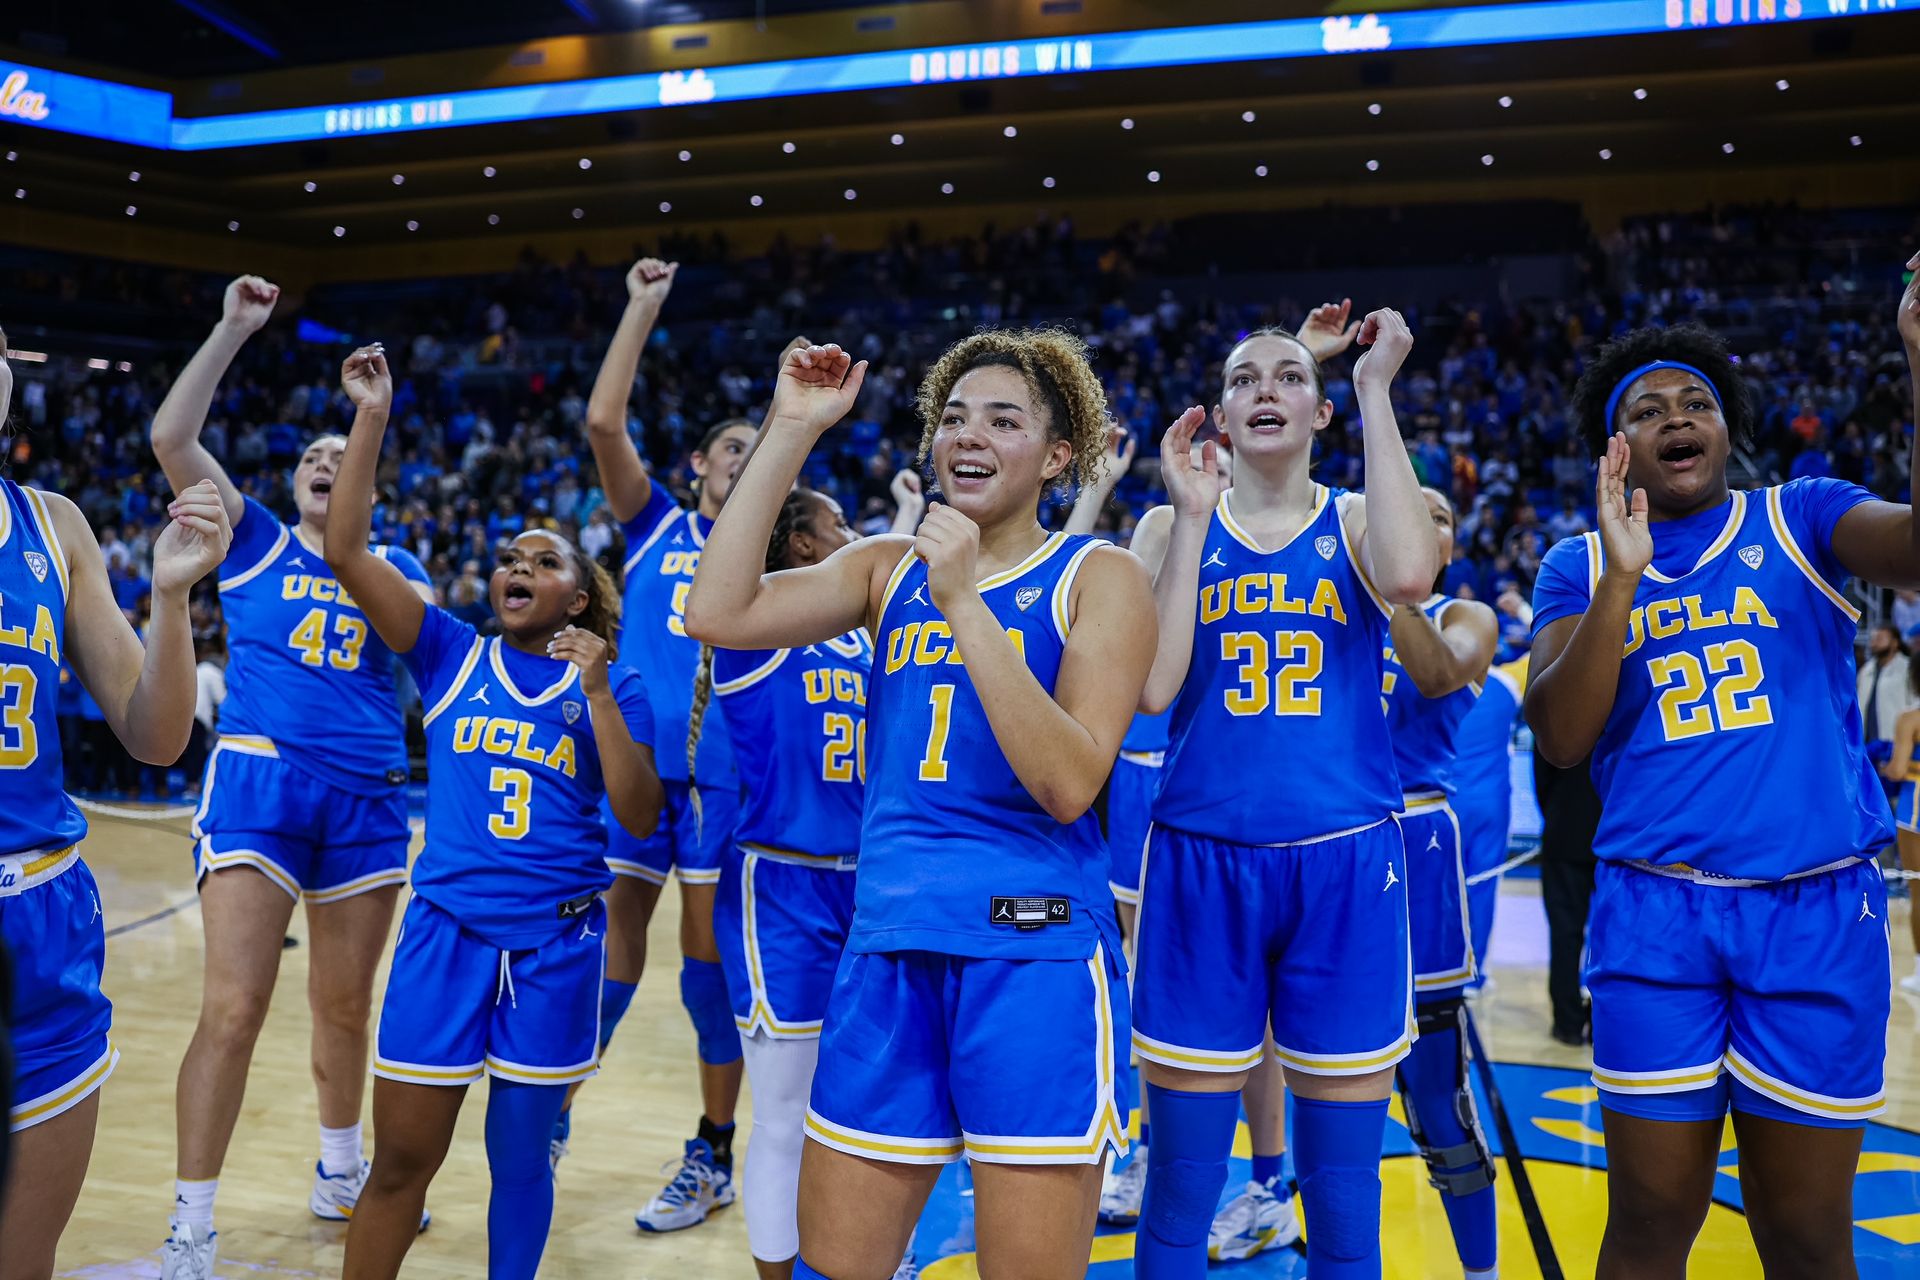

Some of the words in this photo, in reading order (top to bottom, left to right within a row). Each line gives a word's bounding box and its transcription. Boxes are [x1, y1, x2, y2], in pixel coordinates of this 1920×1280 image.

[1666, 0, 1802, 28] BRUINS
[1748, 554, 1758, 564] 12
[1200, 573, 1347, 626] UCLA
[288, 607, 368, 672] 43
[1220, 630, 1323, 716] 32
[1646, 638, 1774, 742] 22
[453, 716, 577, 779] UCLA
[919, 684, 956, 782] 1
[488, 766, 533, 840] 3
[1051, 904, 1065, 915] 42
